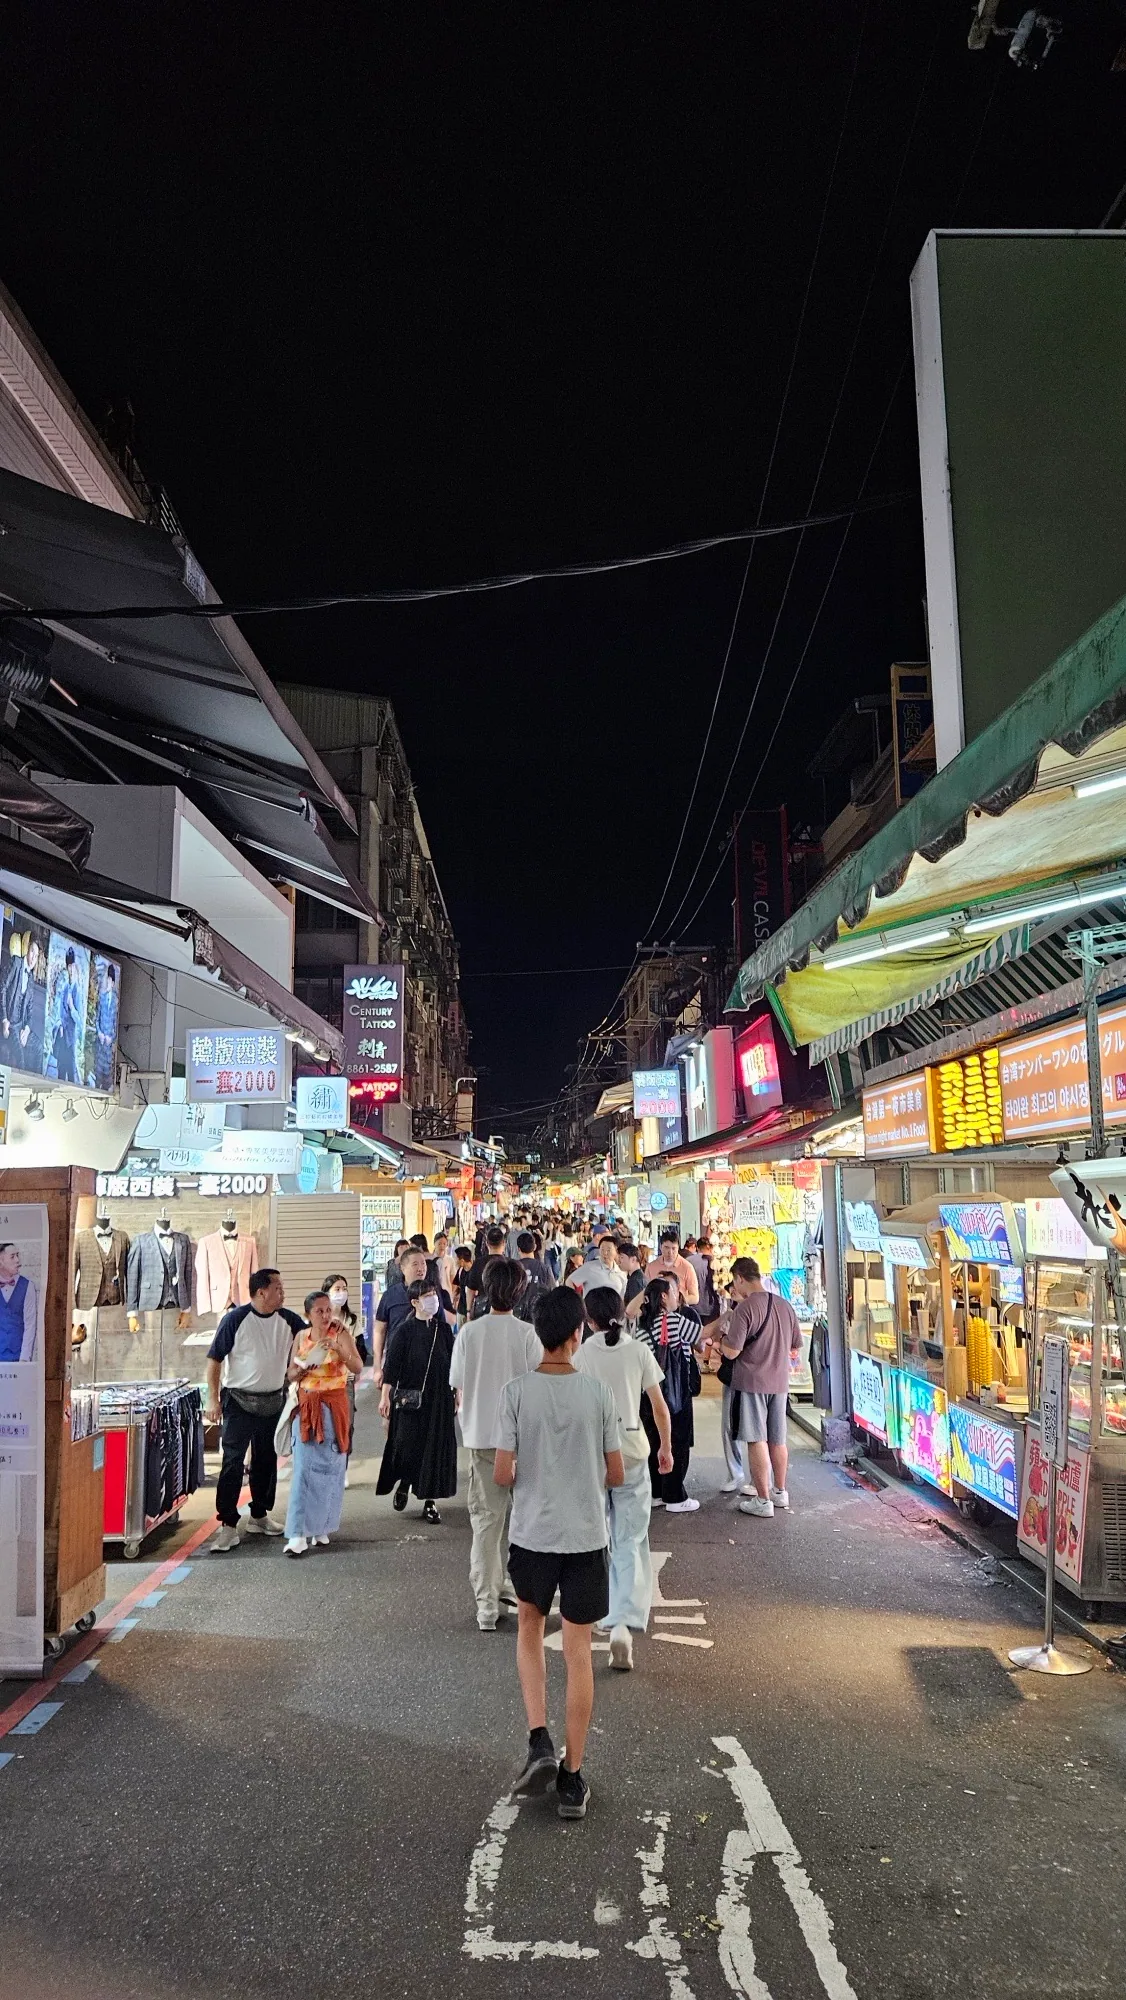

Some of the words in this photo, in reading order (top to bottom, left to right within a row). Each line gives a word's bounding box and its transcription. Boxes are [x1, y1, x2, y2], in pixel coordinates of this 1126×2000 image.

[192, 1035, 278, 1066] 韓版西裝
[357, 1038, 387, 1059] 刺青
[346, 1063, 398, 1074] 8861-2587
[195, 1070, 276, 1094] 一套2000
[362, 1082, 398, 1092] TATTOO
[639, 1101, 677, 1115] 2000
[865, 1089, 923, 1122] 台灣第一夜市美食
[1005, 1100, 1029, 1121] 타이완
[1031, 1090, 1057, 1114] 최고의
[1060, 1081, 1088, 1110] 야시장
[913, 1120, 926, 1137] Food
[959, 1211, 988, 1235] SUPER
